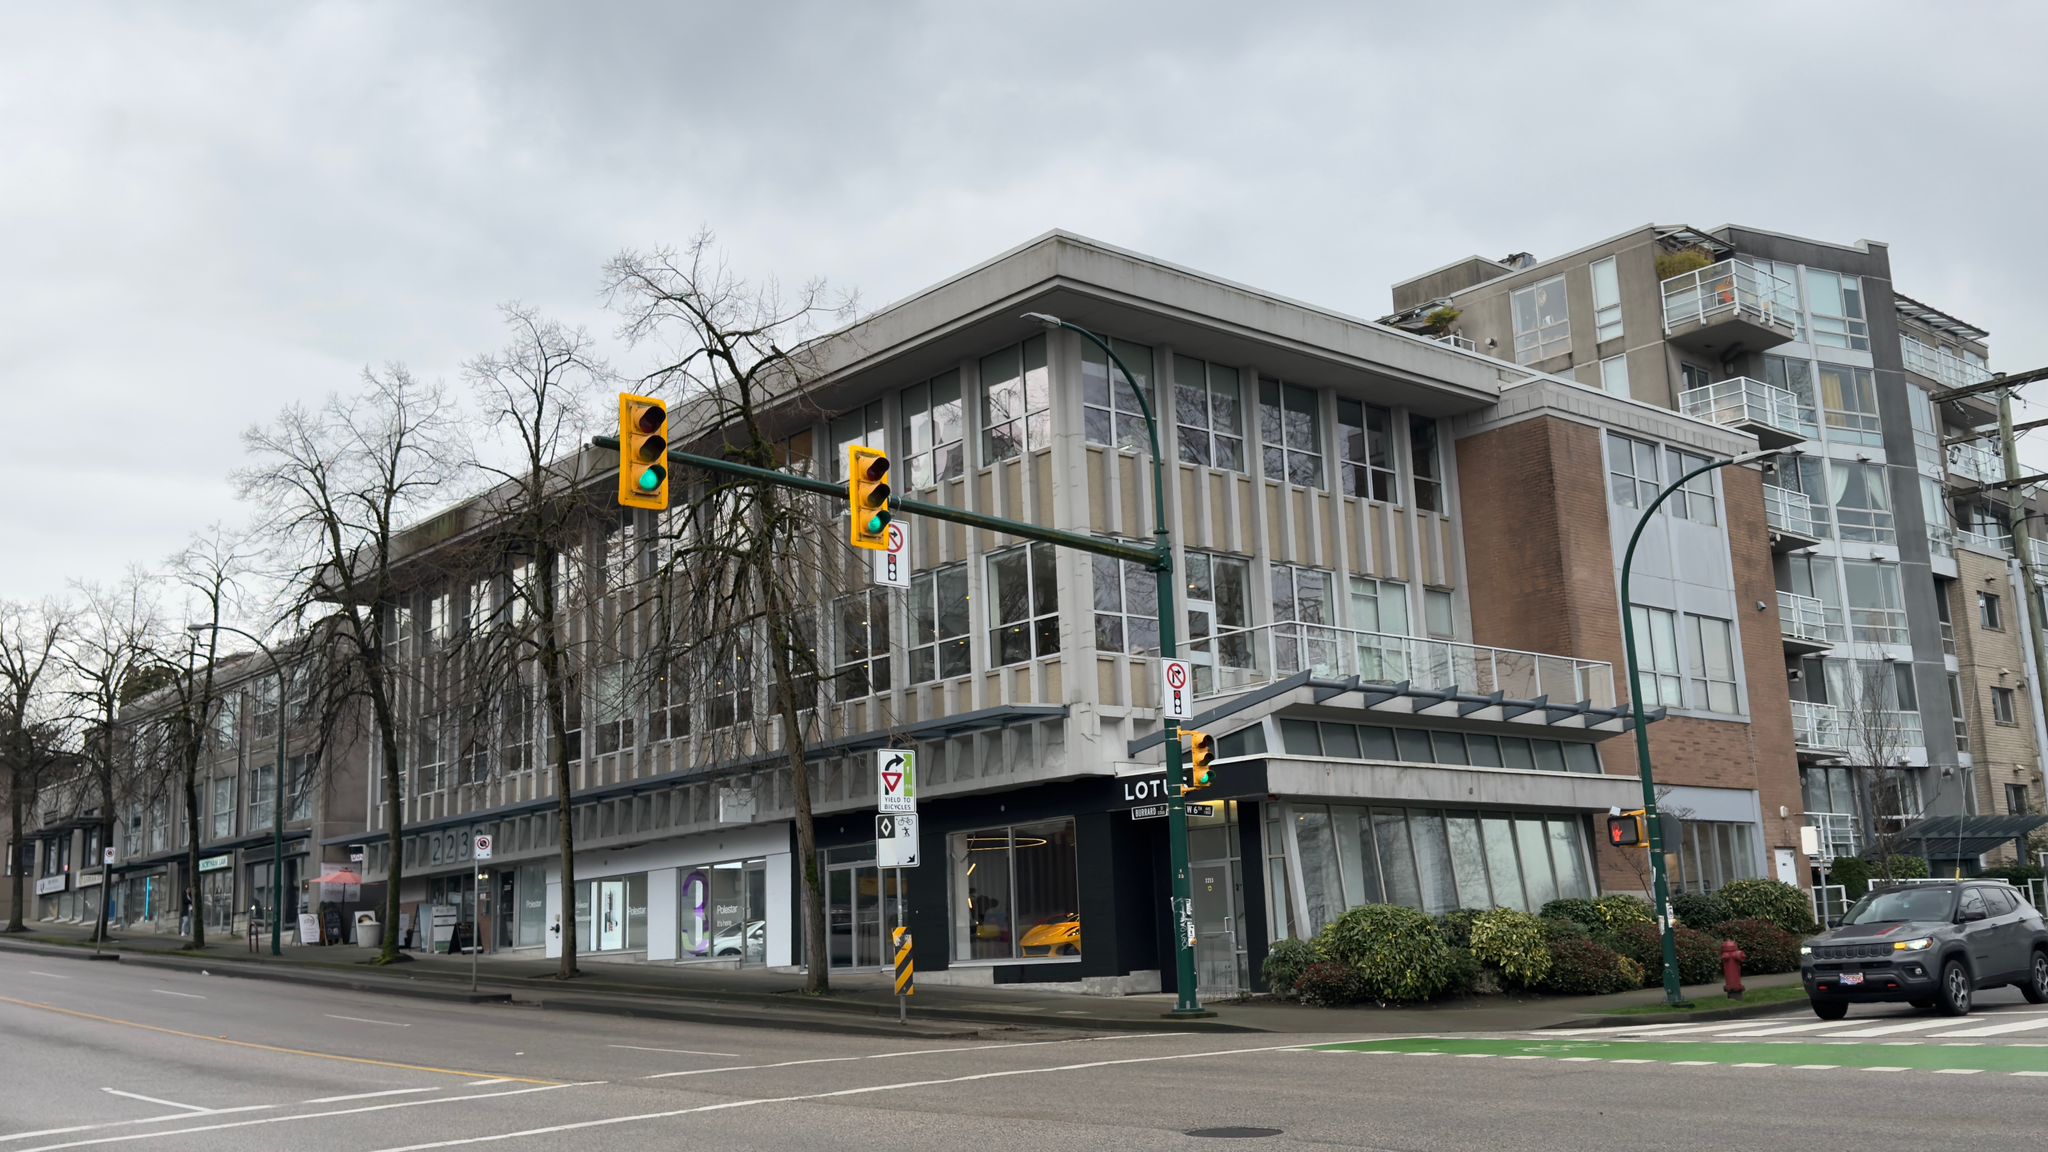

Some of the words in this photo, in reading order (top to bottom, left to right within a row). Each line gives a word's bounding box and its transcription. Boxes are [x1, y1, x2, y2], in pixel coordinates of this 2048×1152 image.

[1135, 808, 1157, 818] BURRARD
[1187, 806, 1193, 814] W
[628, 906, 646, 916] Polestar
[716, 905, 738, 914] Polestar
